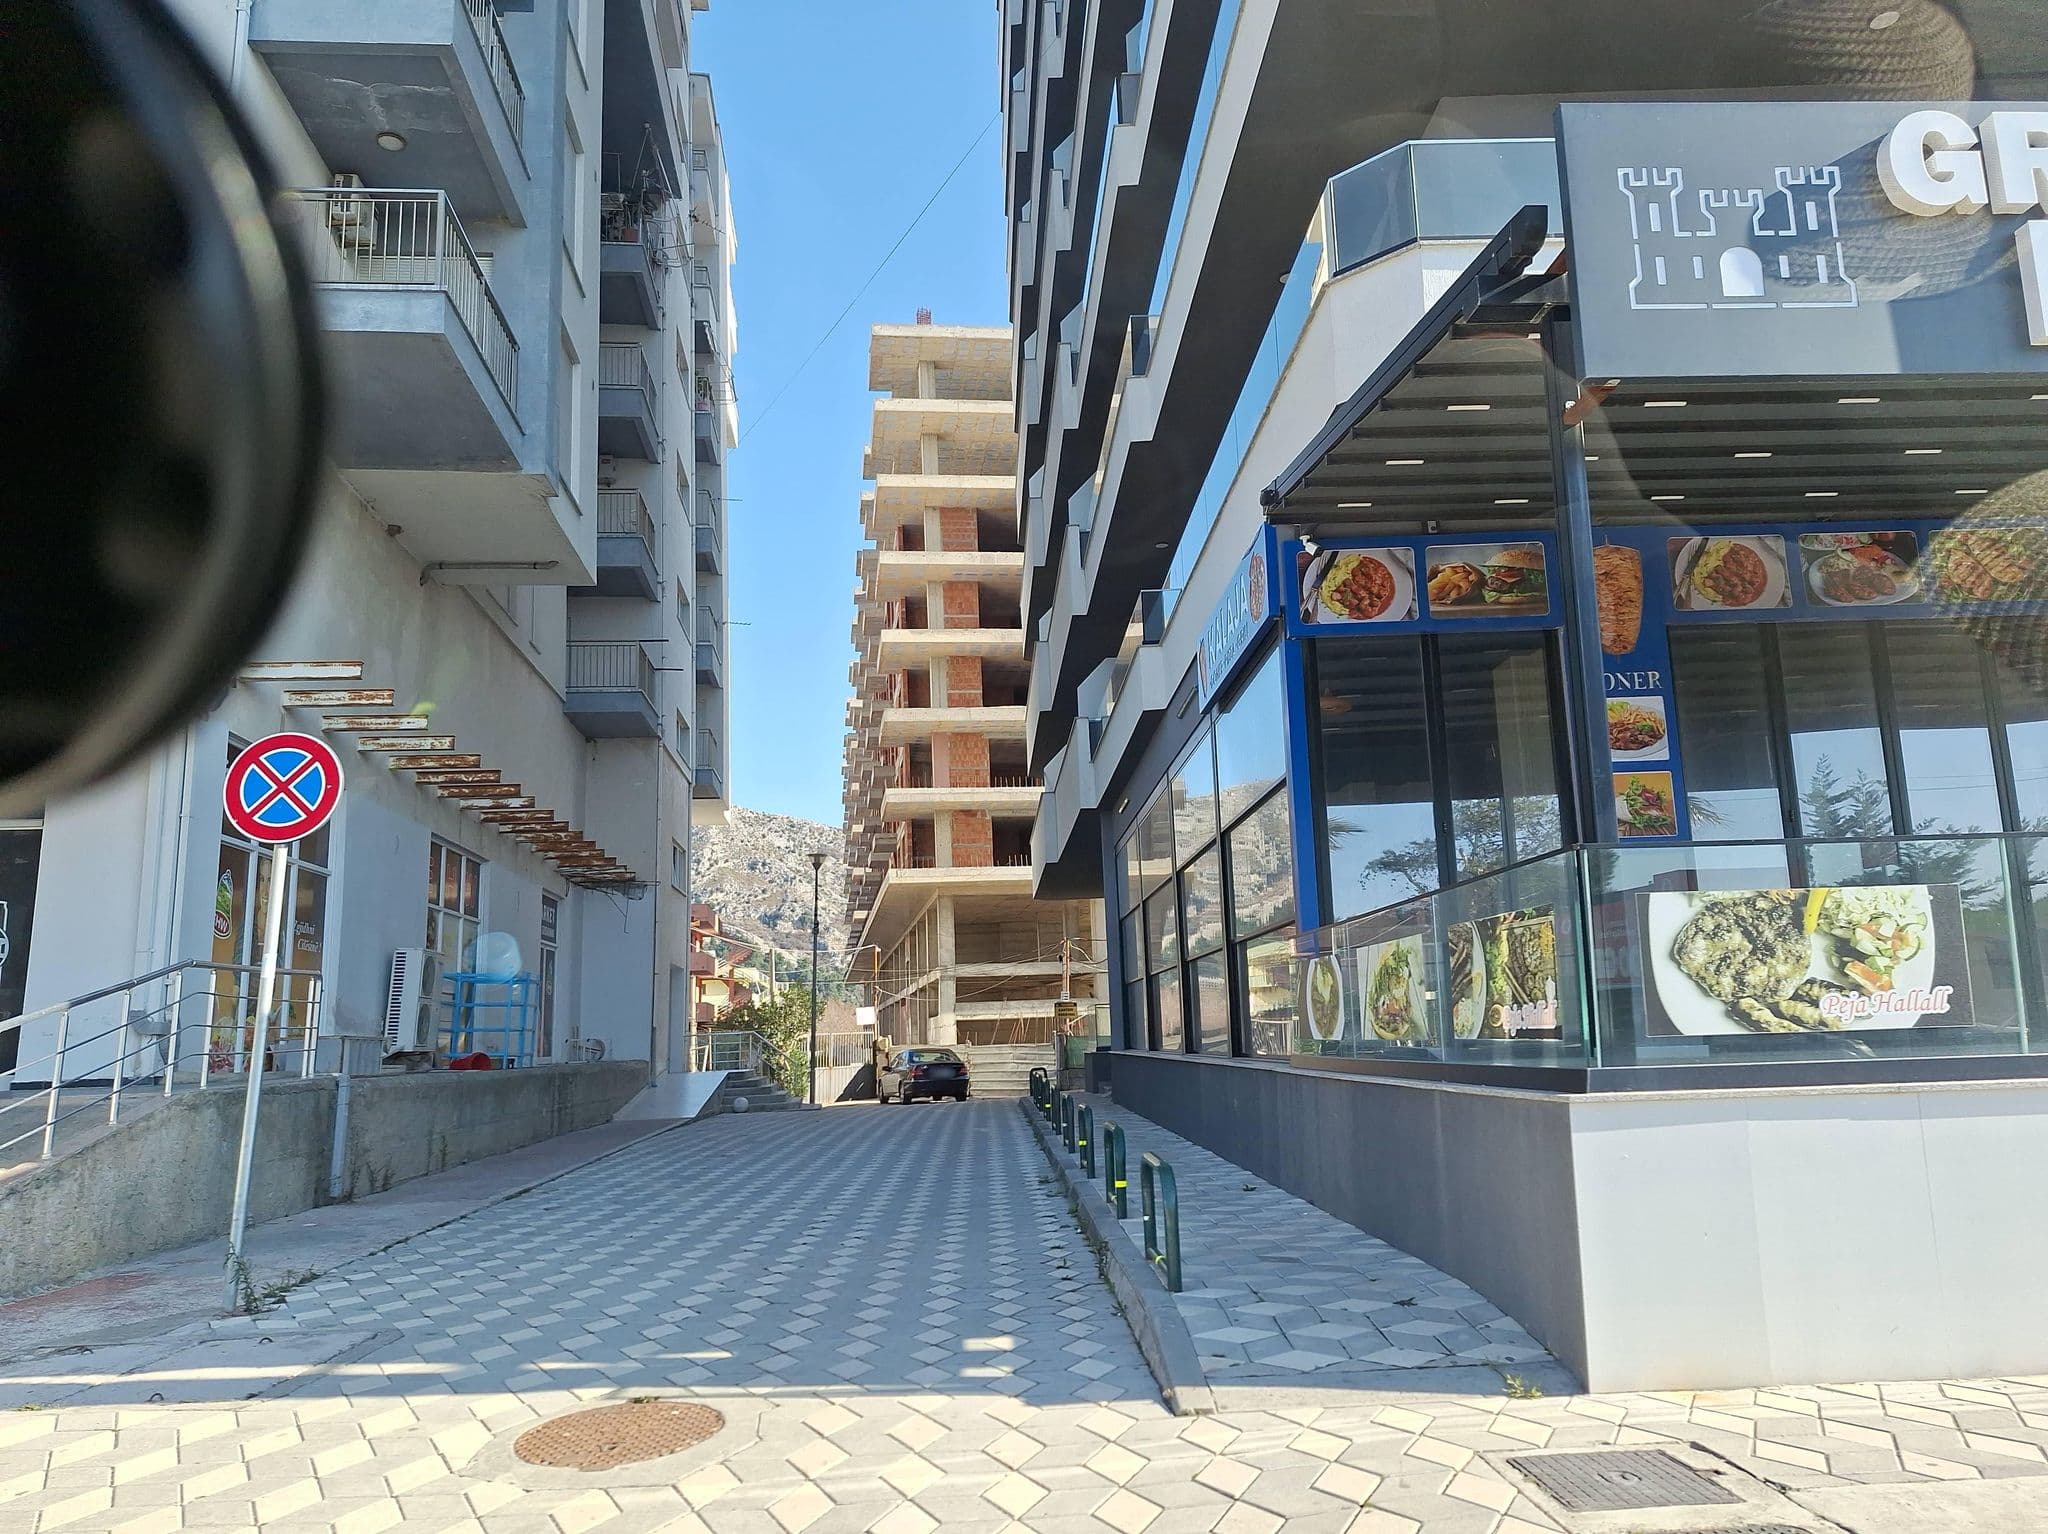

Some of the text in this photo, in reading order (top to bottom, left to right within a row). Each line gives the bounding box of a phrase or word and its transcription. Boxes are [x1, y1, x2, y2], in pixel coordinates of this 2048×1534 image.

[1207, 573, 1249, 669] KALAJA
[1823, 988, 1950, 1021] Peja Hallall
